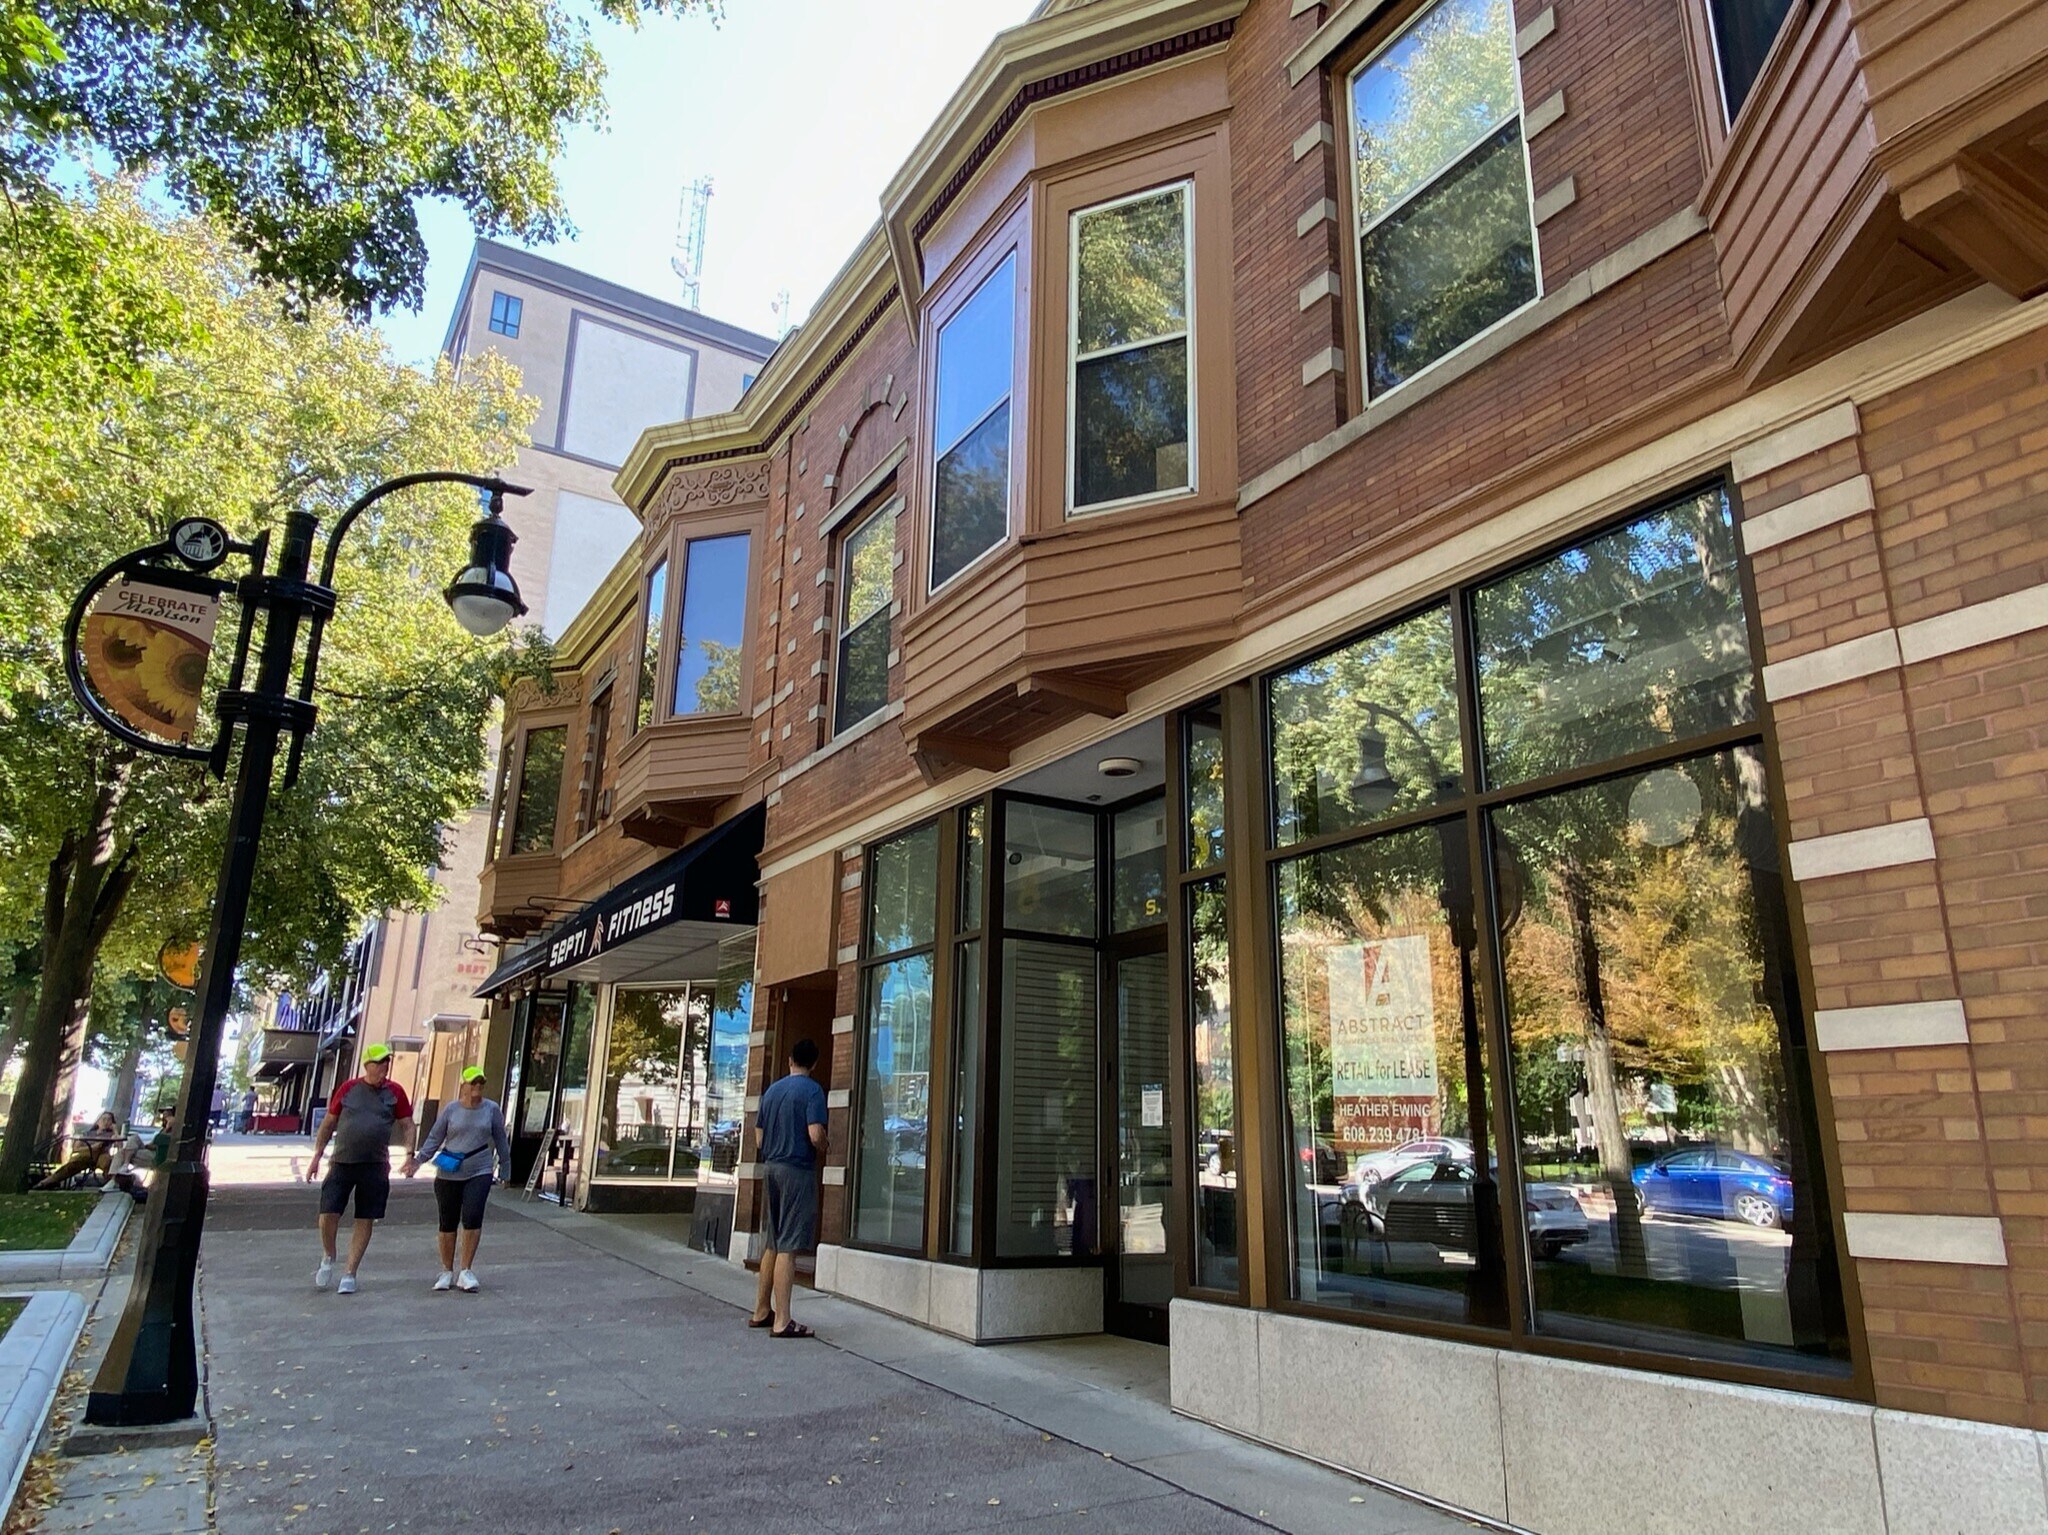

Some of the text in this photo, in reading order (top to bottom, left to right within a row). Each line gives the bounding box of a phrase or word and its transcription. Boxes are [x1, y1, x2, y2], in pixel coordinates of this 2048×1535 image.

[112, 600, 201, 624] Madison
[119, 591, 207, 615] CELEBRATE
[1337, 1014, 1425, 1035] ABSTRACT
[1337, 1059, 1431, 1081] RETAIL for LEASE
[1339, 1102, 1431, 1118] HEATHER EWING
